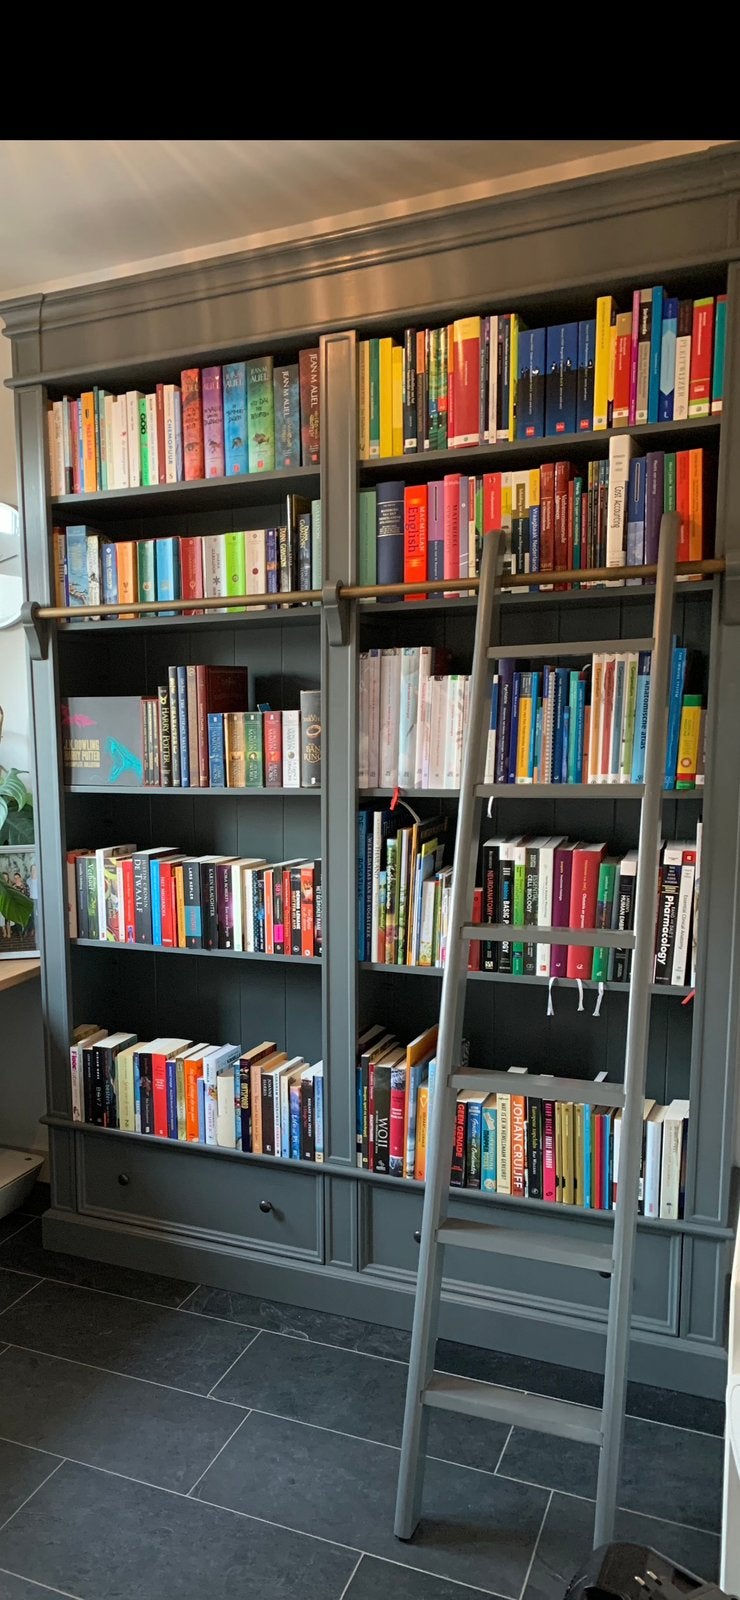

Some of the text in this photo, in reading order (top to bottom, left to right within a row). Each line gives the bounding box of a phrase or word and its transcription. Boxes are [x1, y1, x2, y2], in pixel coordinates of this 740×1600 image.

[251, 373, 268, 383] AUEL
[309, 353, 318, 374] JEAN
[310, 375, 317, 383] M
[678, 339, 686, 397] PLEITWIJZER
[310, 385, 318, 408] AUEL
[611, 486, 624, 528] Cost Accounting
[405, 507, 419, 553] English
[641, 680, 649, 729] Anatomische
[161, 707, 170, 764] HARRY POTTER
[135, 859, 141, 870] DE
[658, 895, 674, 965] Pharmacology
[457, 1104, 465, 1125] GEEN
[378, 1118, 388, 1148] WOII
[513, 1101, 523, 1189] JOHAN CRUIJFF
